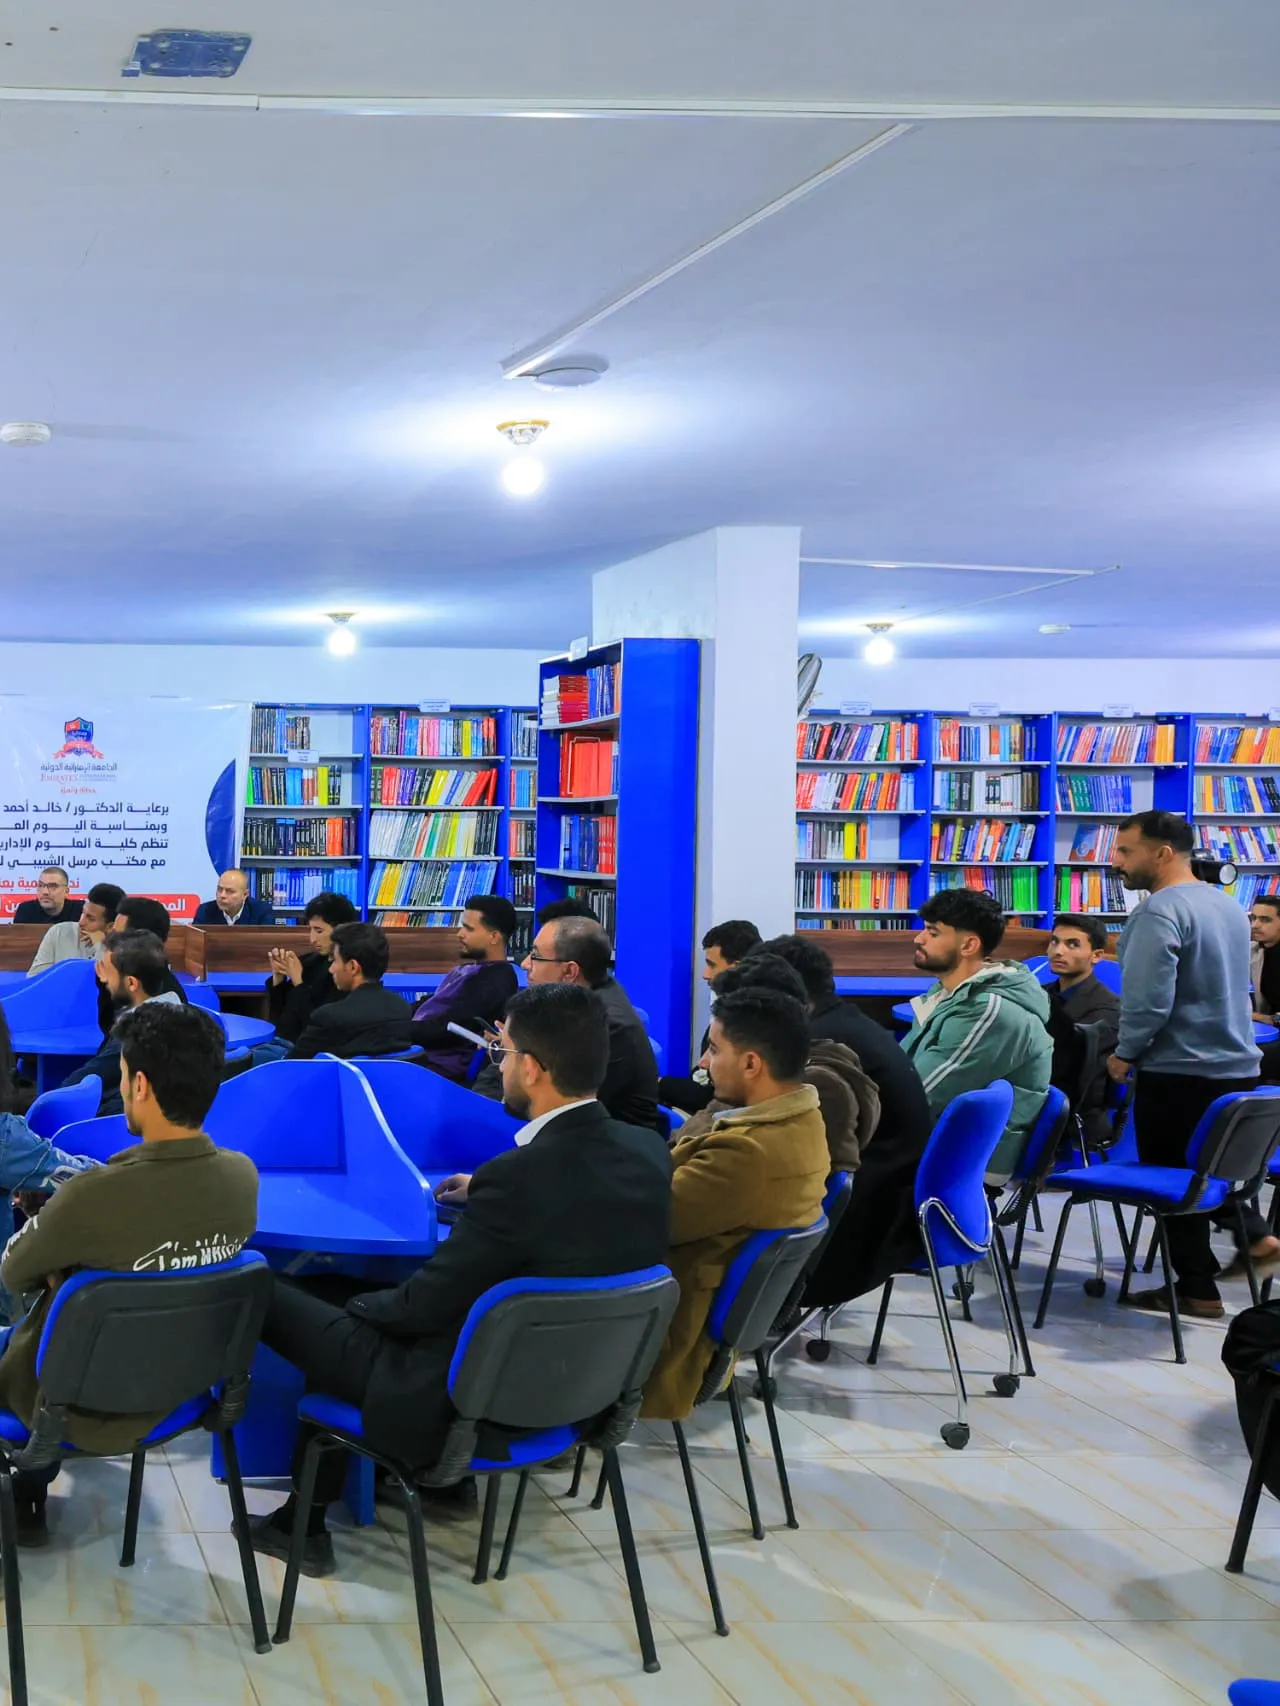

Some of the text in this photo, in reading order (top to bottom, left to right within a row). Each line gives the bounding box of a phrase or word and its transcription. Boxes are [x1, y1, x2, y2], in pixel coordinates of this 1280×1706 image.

[3, 800, 29, 813] أحمد
[32, 801, 62, 813] خالد
[73, 801, 123, 817] الدكتور
[127, 802, 169, 816] برعاية
[32, 820, 87, 834] اليوم
[90, 819, 167, 834] وبمناسبة
[34, 837, 91, 851] العلوم
[95, 838, 137, 850] كلية
[140, 838, 168, 849] تنظم
[7, 855, 64, 869] الشبيبي
[67, 855, 98, 869] مرسل
[101, 856, 147, 869] مكتب
[150, 858, 166, 870] مع
